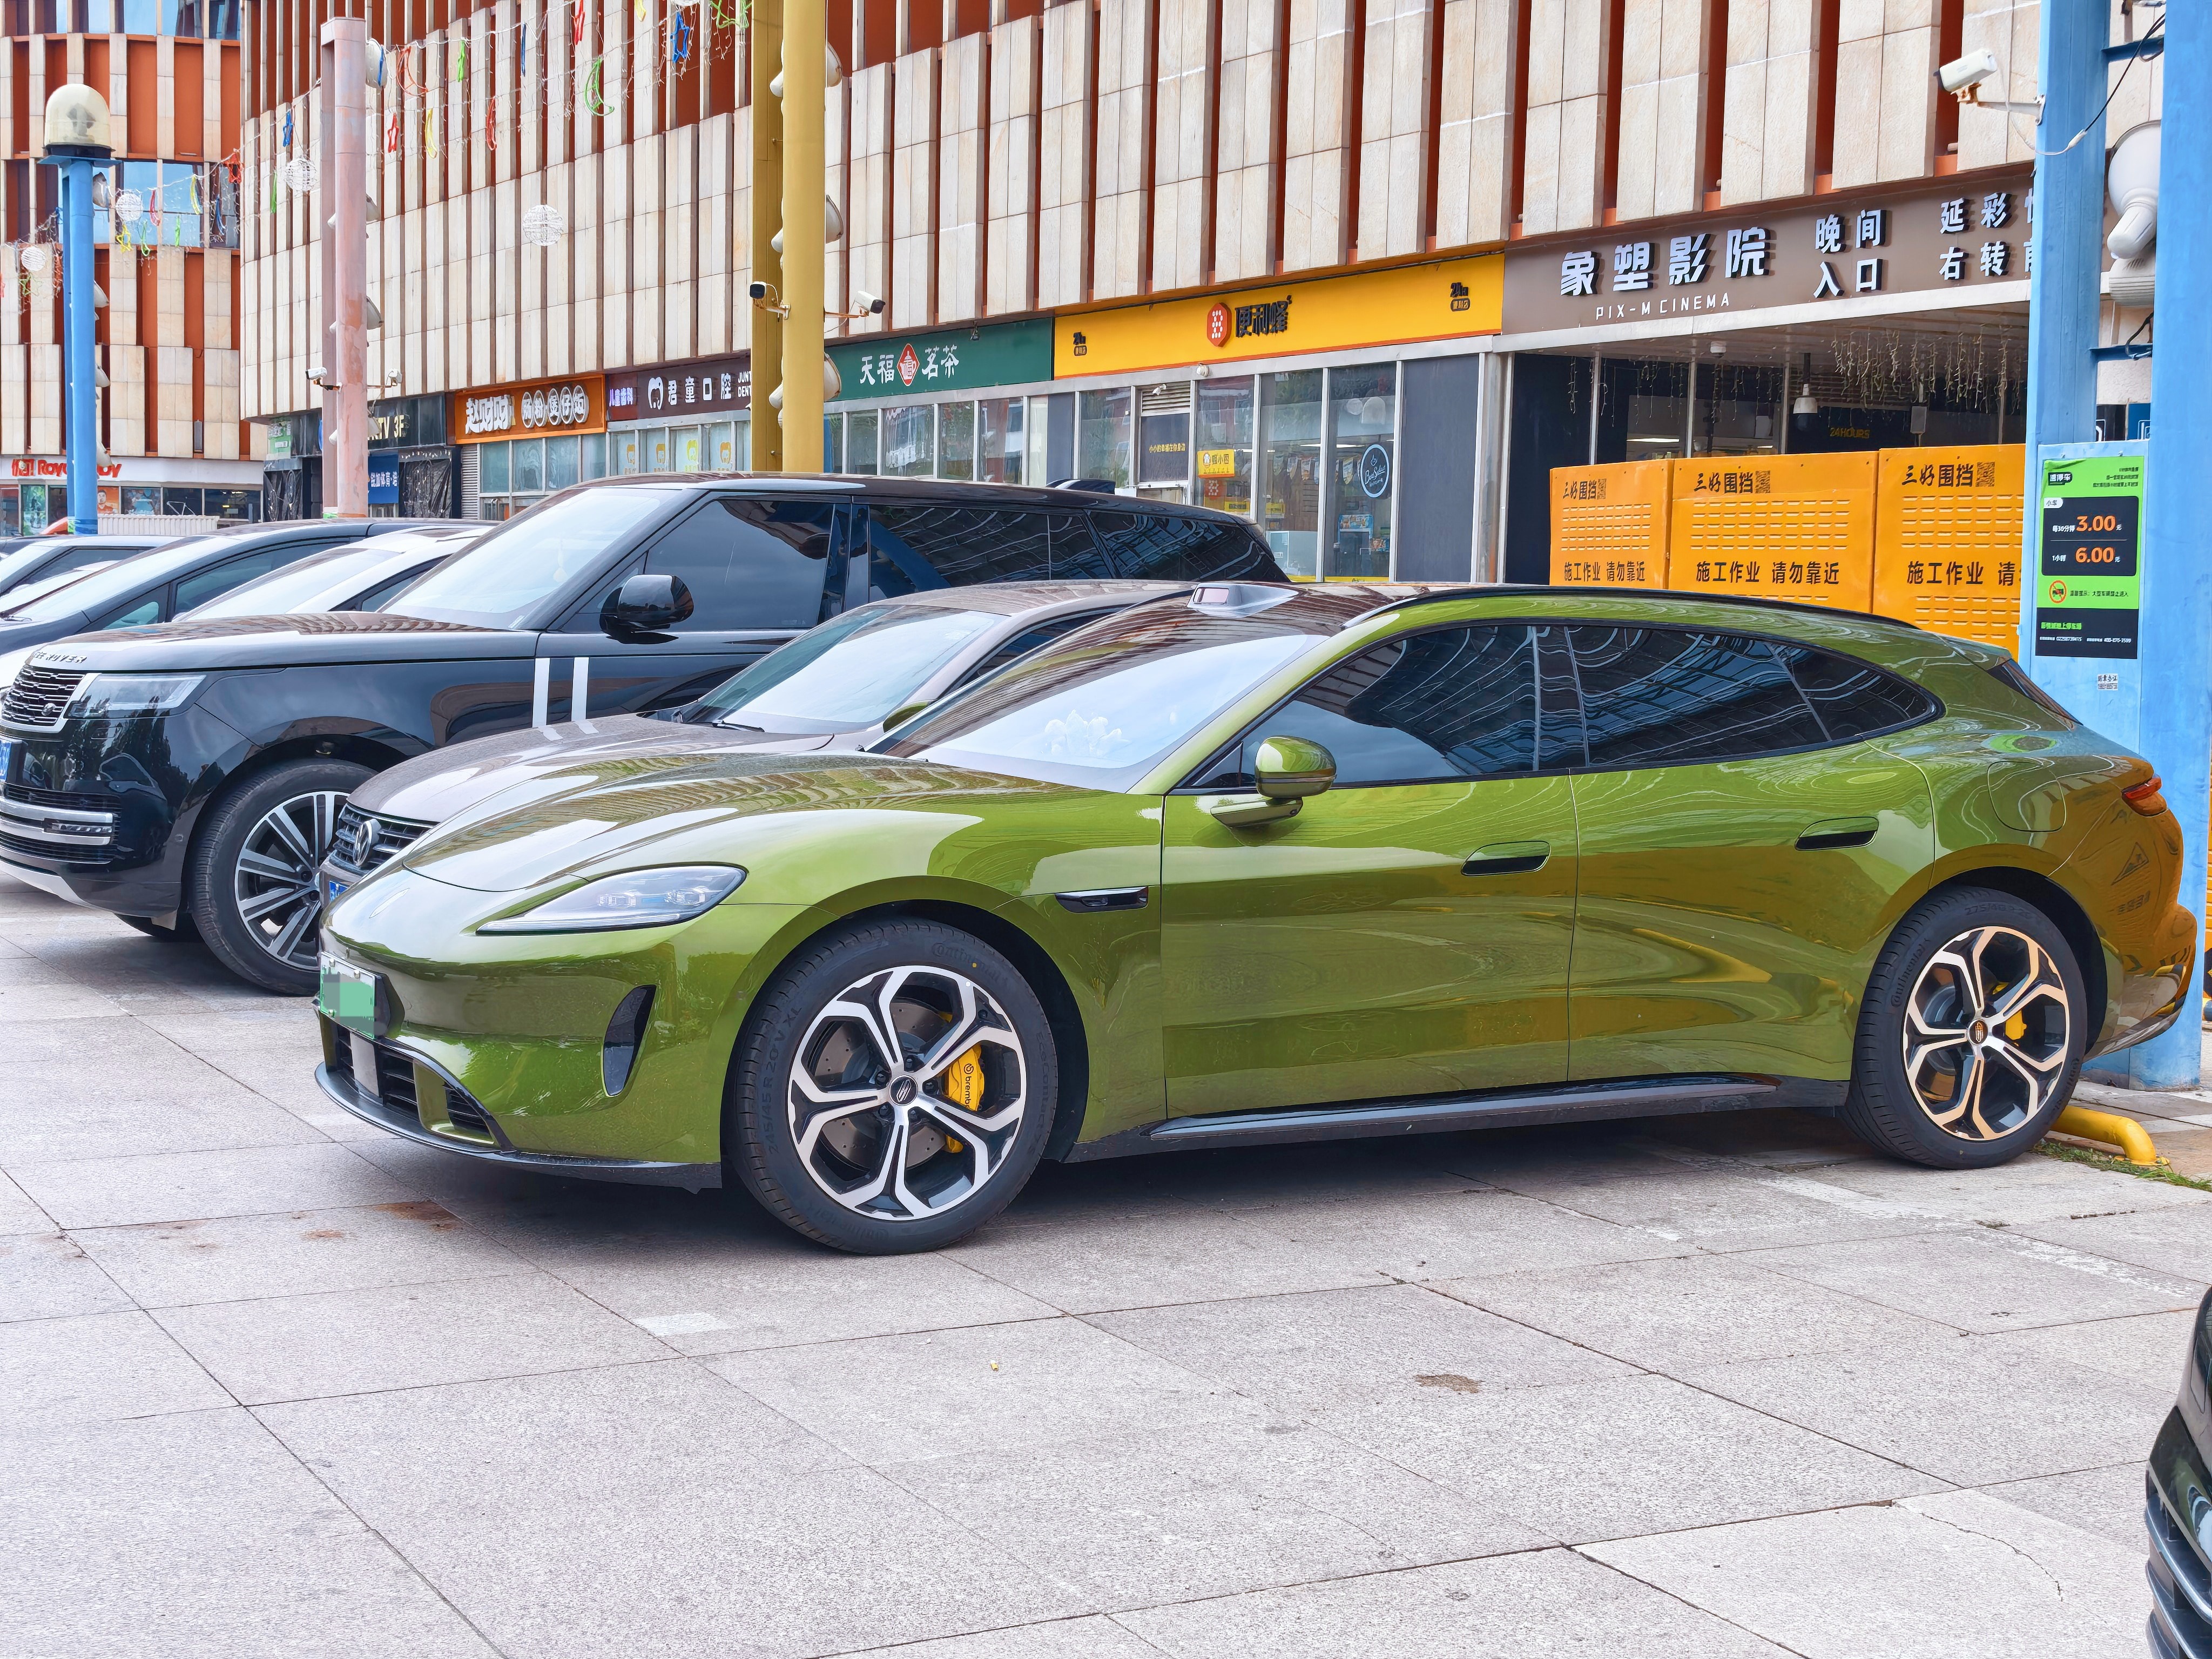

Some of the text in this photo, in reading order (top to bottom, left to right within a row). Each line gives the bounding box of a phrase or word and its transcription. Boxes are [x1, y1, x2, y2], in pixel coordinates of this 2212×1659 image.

[1815, 209, 1885, 254] 晚间
[1560, 227, 1769, 296] 象塑影院
[1813, 258, 1881, 299] 入口
[1235, 297, 1291, 338] 便利蜂
[1596, 293, 1729, 320] PIX-M CINEMA
[860, 354, 894, 385] 天福
[921, 344, 959, 380] 茗茶
[668, 373, 731, 405] 君童口腔
[1694, 472, 1753, 494] 三好围挡
[1901, 463, 1974, 488] 三好围挡
[1563, 480, 1597, 500] 三好围挡
[2076, 515, 2116, 531] 3.00
[2075, 547, 2114, 563] 6.00
[1564, 561, 1645, 582] 施工作业 请勿靠近
[1696, 561, 1839, 584] 施工作业 请勿靠近
[1907, 561, 2021, 586] 施工作业 请
